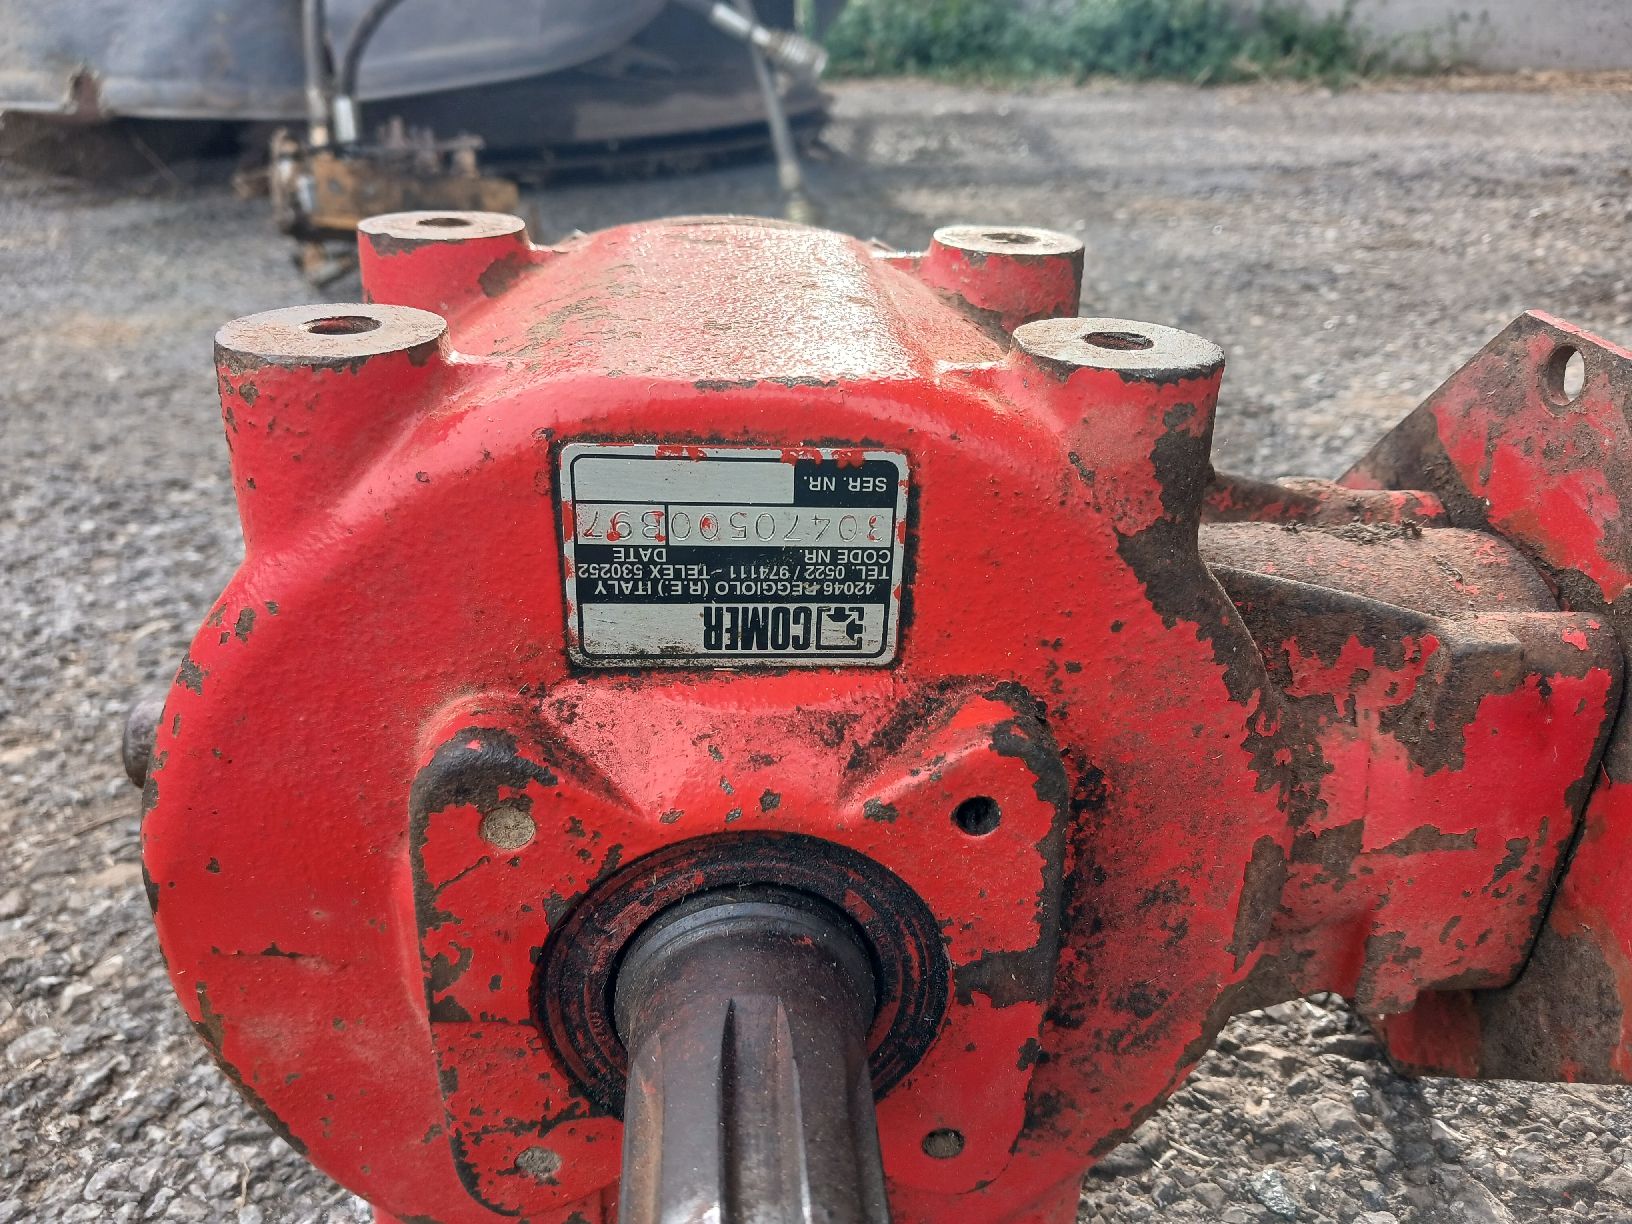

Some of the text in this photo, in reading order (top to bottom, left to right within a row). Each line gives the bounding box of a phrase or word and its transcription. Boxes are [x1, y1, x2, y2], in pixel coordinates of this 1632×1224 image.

[803, 476, 887, 492] SER. NR.
[583, 510, 666, 542] B97
[671, 512, 884, 542] 30470500
[612, 547, 667, 562] DATE
[799, 549, 891, 564] CODE NR.
[578, 563, 643, 578] 530252
[650, 563, 711, 579] TELEX
[730, 565, 790, 580] 974111
[793, 564, 800, 580] /
[804, 565, 846, 580] 0522
[851, 565, 890, 580] TEL.
[594, 580, 875, 597] 42046 REGGIOLO (R.E.) ITALY
[704, 606, 812, 650] COMER
